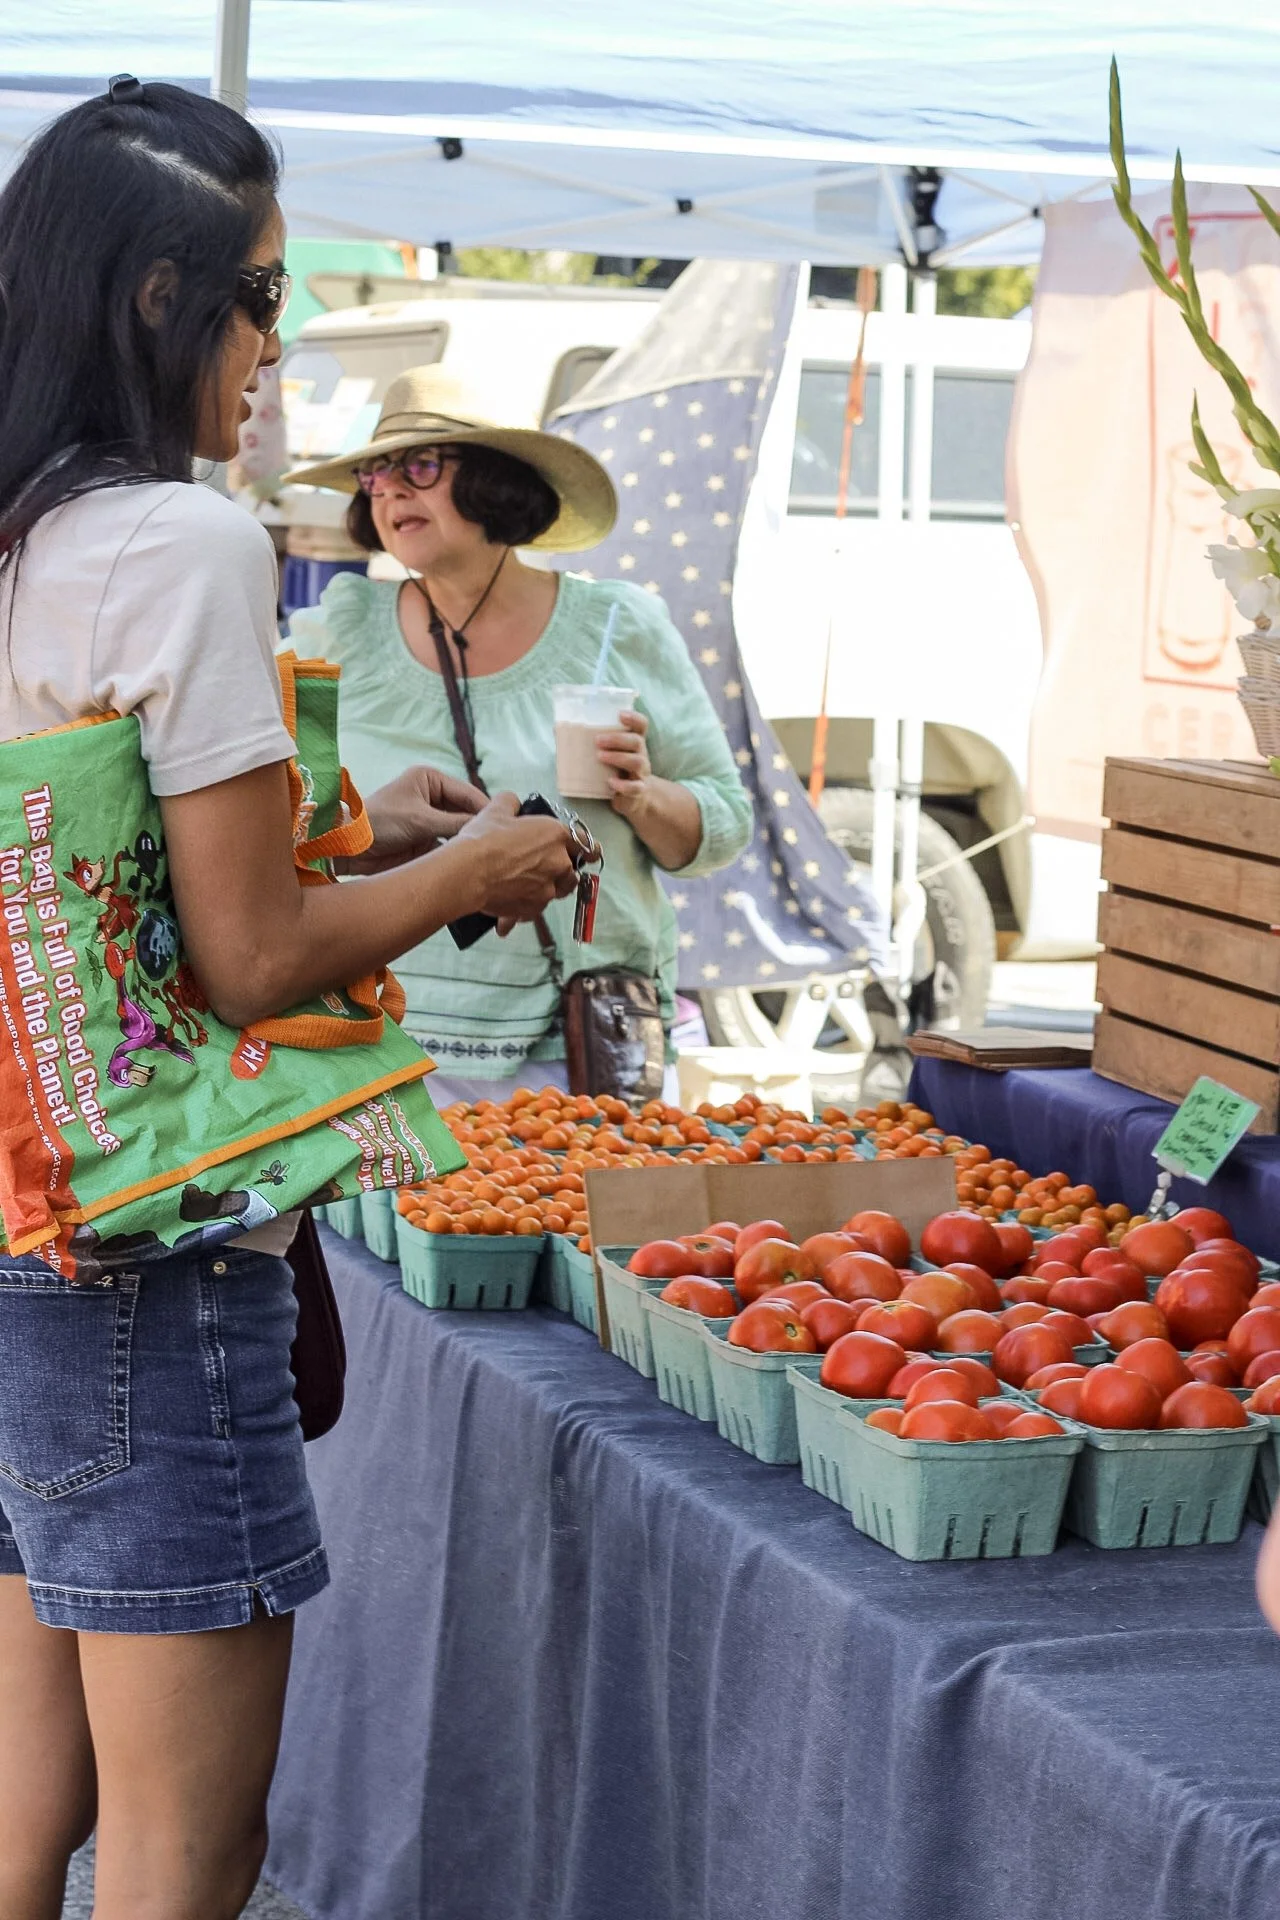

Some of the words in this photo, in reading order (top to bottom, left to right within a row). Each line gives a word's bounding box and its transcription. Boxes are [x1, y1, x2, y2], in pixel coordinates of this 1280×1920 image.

[23, 784, 54, 842] This
[0, 848, 25, 884] for
[30, 845, 55, 893] Bag
[3, 889, 29, 935] You
[35, 894, 62, 919] is
[10, 940, 45, 989] and
[43, 921, 77, 969] Full
[55, 973, 82, 999] of
[21, 990, 50, 1035] the
[60, 1002, 93, 1067] Good
[13, 1040, 29, 1071] DAIRY
[26, 1078, 36, 1106] 100%
[32, 1106, 62, 1167] FREE-RANGE
[33, 1037, 77, 1127] Planet!
[73, 1067, 121, 1157] Choices
[328, 1116, 362, 1139] opping
[360, 1139, 376, 1160] trip
[363, 1099, 384, 1114] ach
[379, 1115, 395, 1140] time
[393, 1140, 410, 1160] you
[403, 1162, 416, 1185] sho
[375, 1137, 396, 1155] and
[361, 1160, 375, 1172] to
[382, 1158, 398, 1187] We'll
